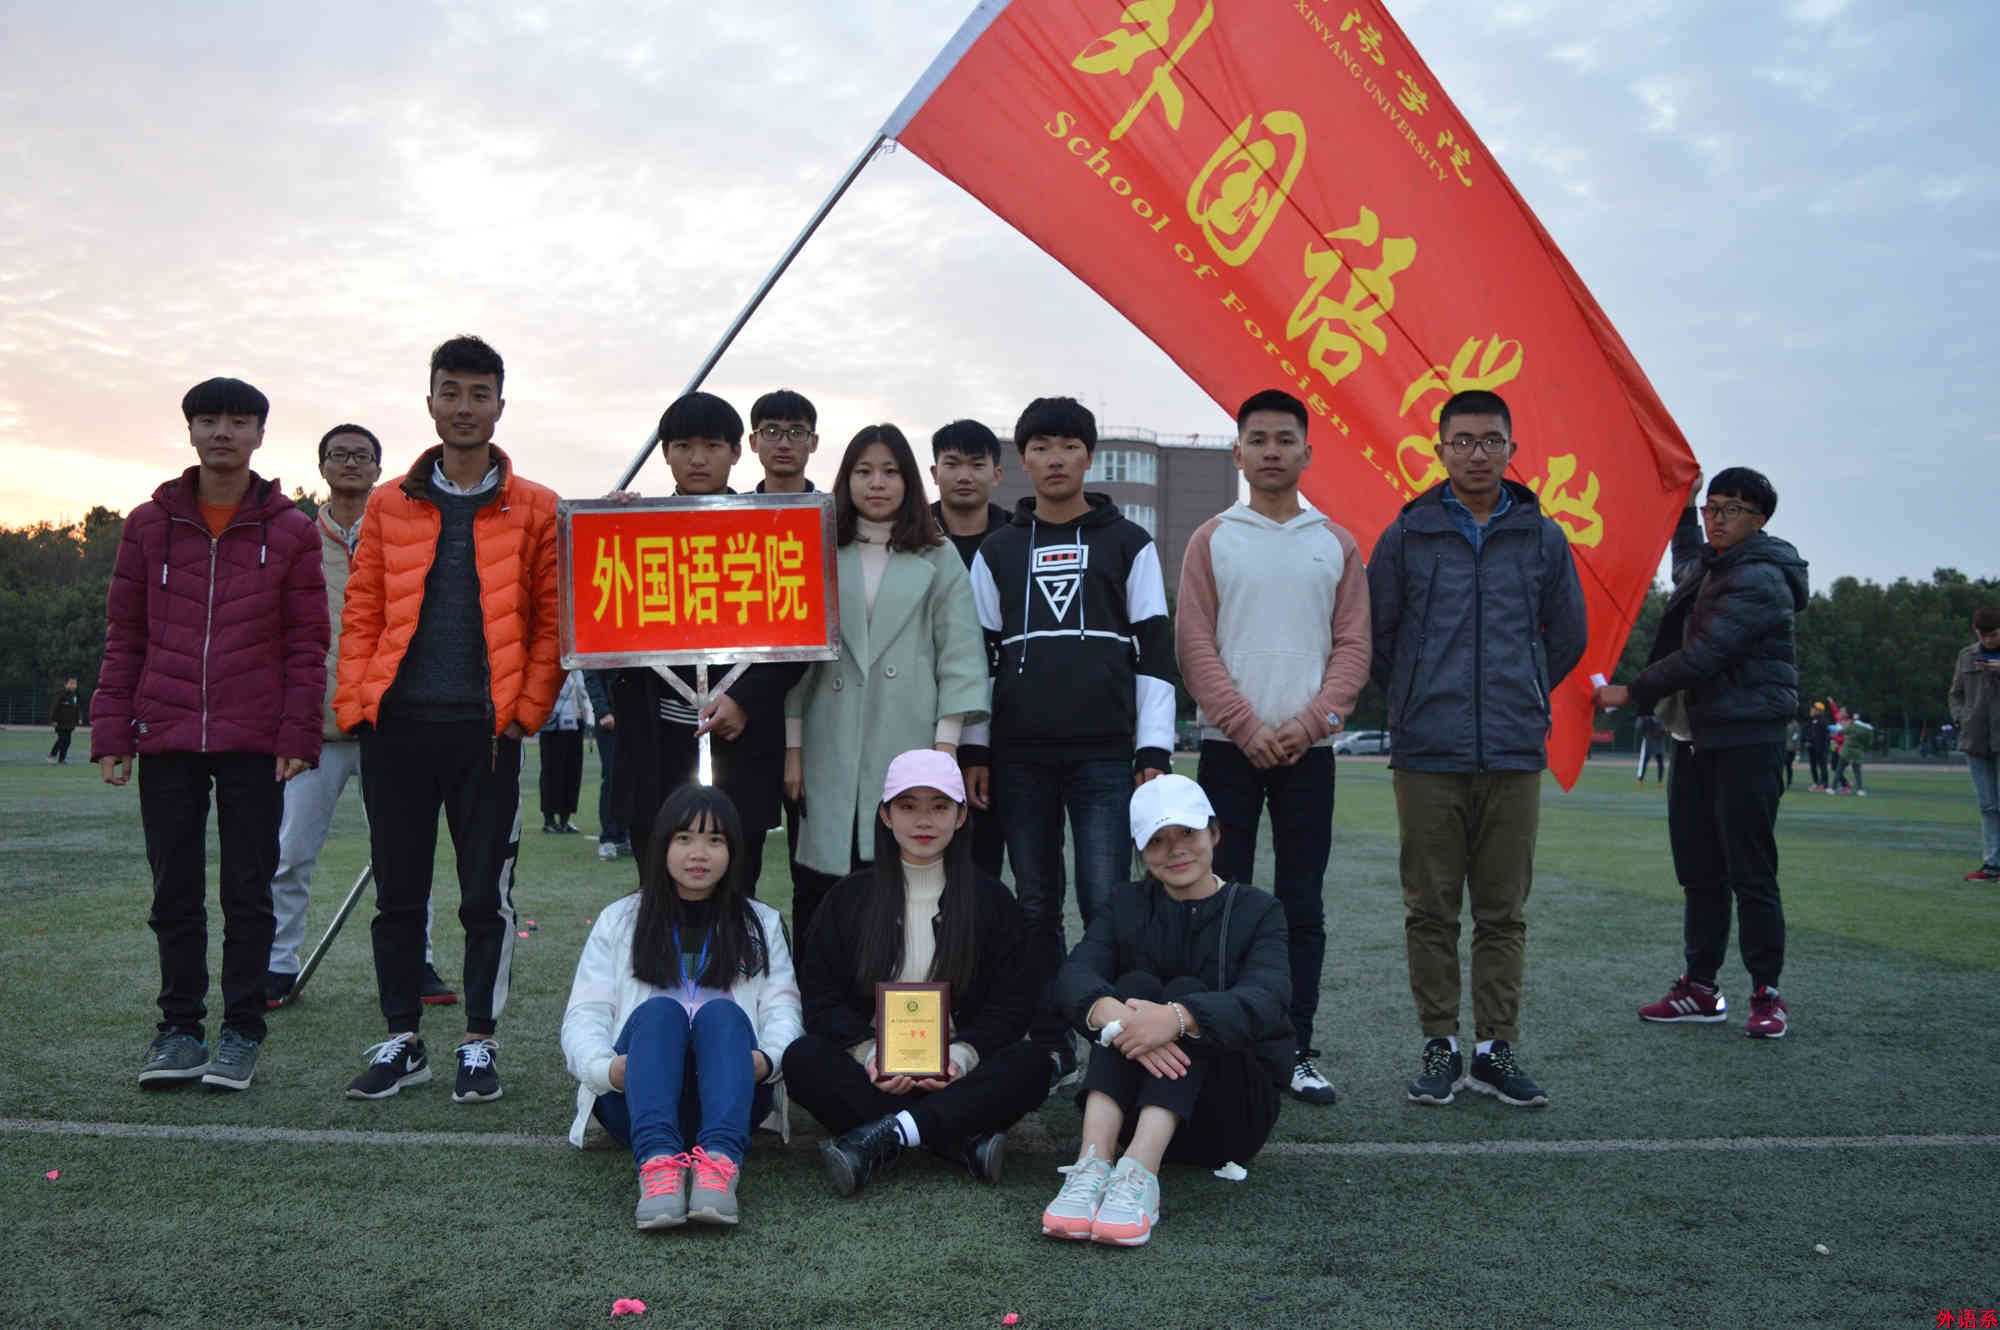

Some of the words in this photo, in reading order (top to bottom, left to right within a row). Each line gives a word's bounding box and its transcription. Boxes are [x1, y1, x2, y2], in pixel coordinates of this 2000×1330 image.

[1293, 1, 1363, 79] XINYANG
[1363, 77, 1448, 182] UNIVERSITY
[1044, 111, 1171, 232] School
[1174, 243, 1219, 280] of
[1220, 290, 1350, 438] Foreign
[592, 530, 808, 628] 外国语学院
